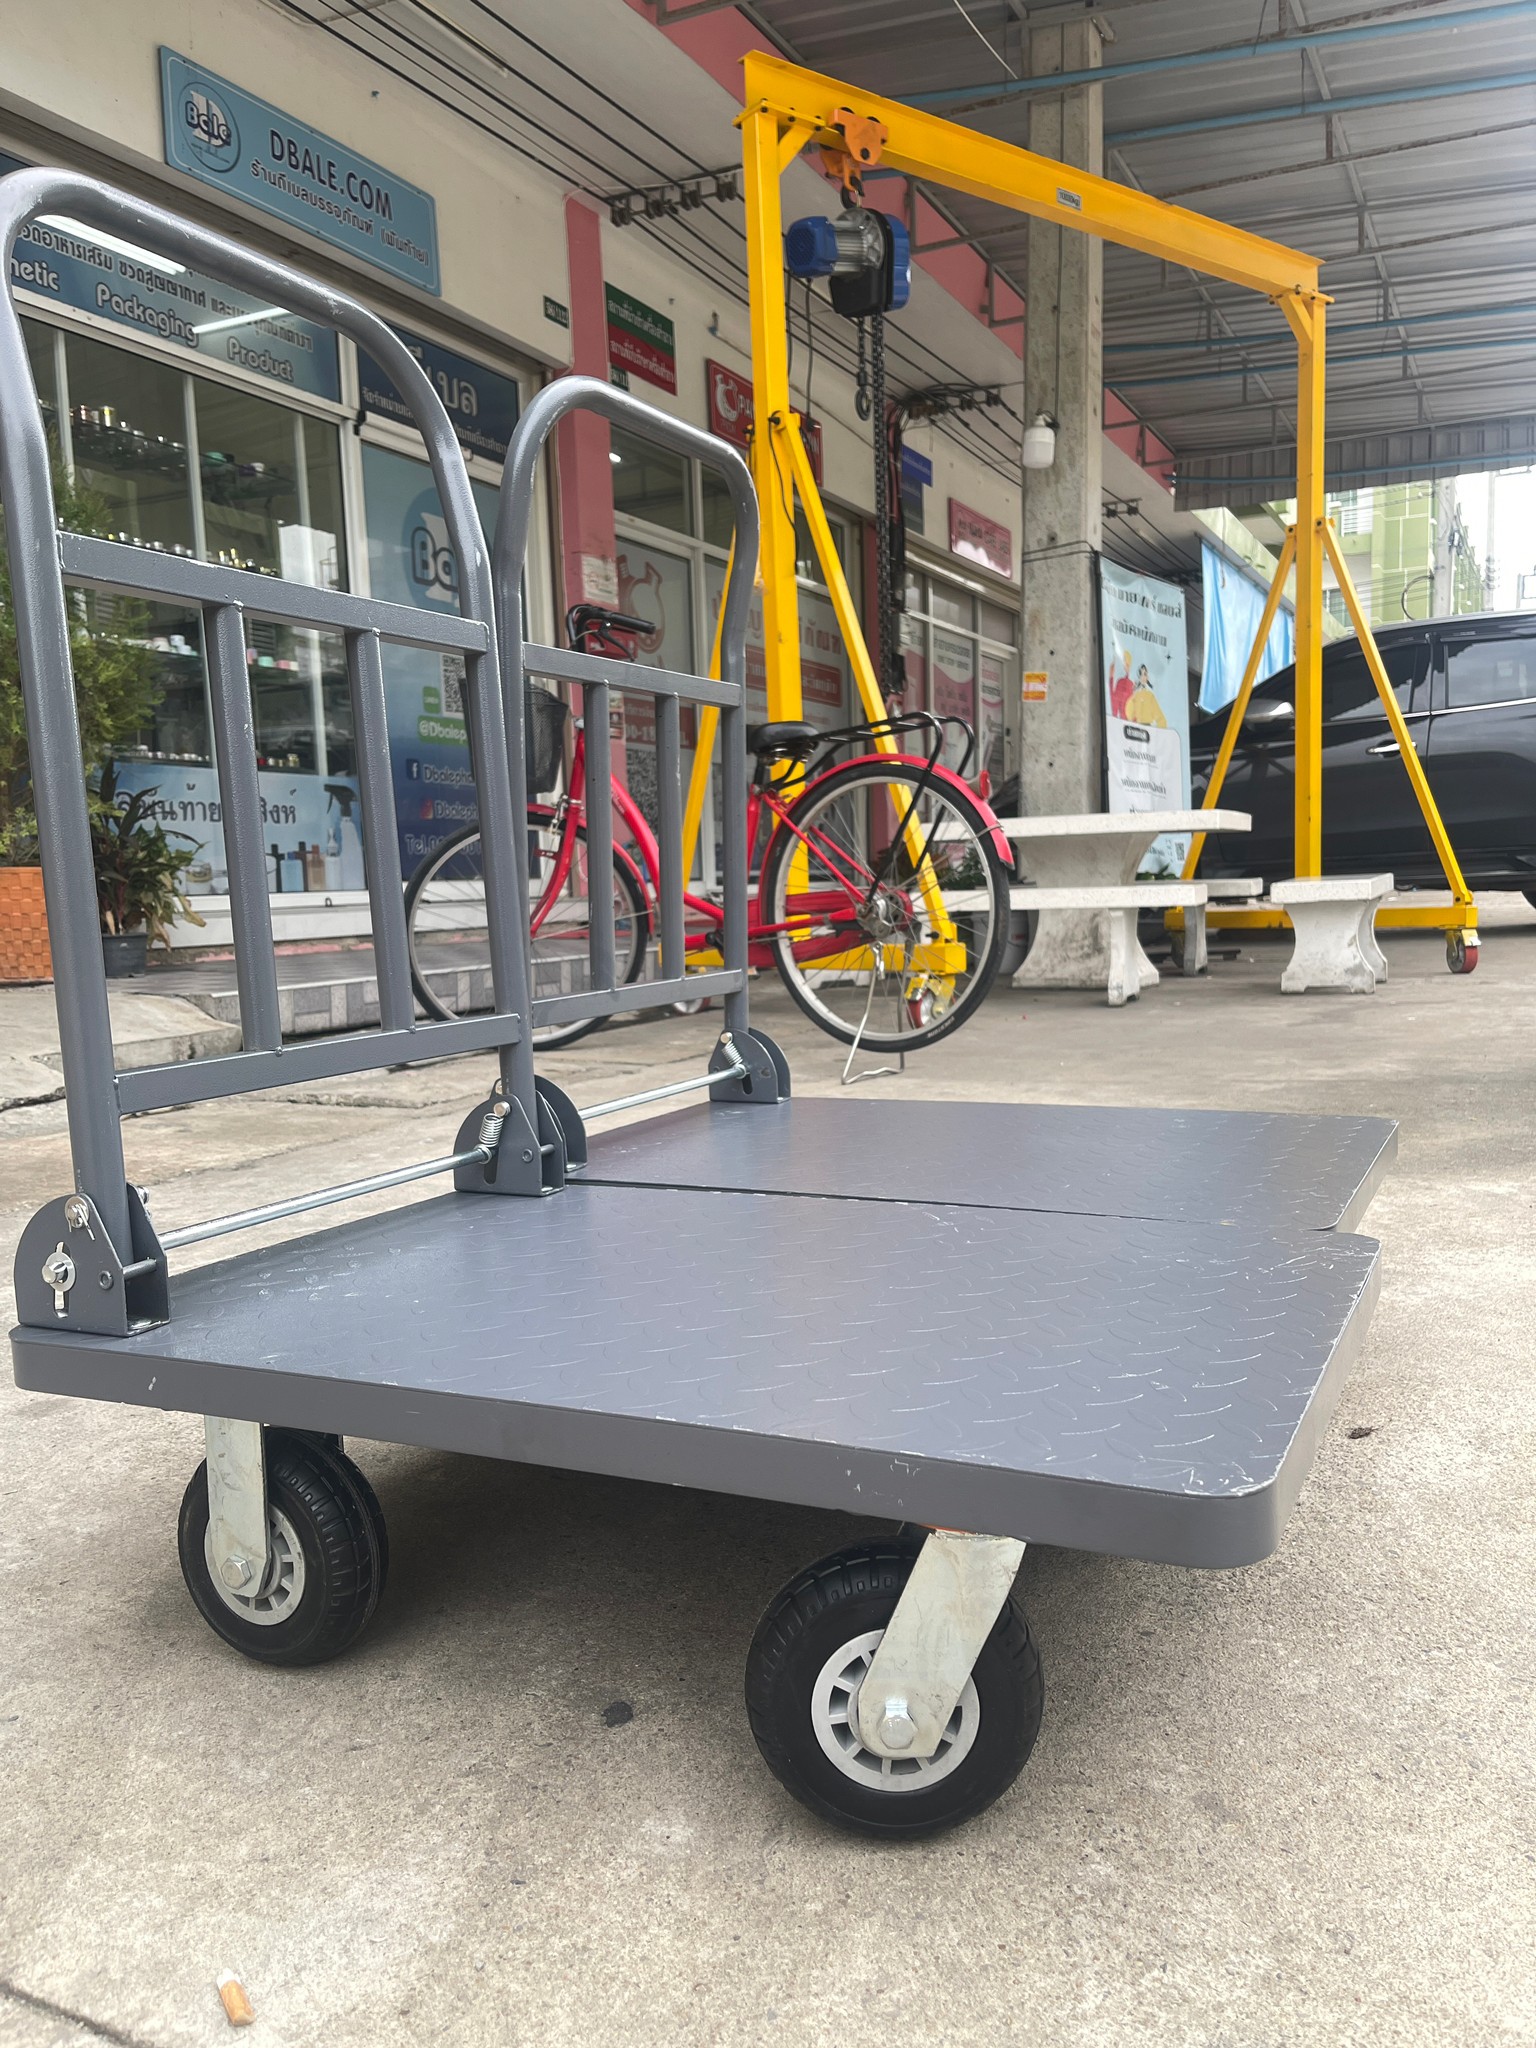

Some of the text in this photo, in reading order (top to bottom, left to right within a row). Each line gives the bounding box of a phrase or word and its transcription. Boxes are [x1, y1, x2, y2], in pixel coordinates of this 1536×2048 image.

[269, 128, 393, 222] DBALE.COM
[18, 223, 114, 272] วดอาหารเสริม
[96, 282, 200, 349] Packaging
[226, 335, 294, 383] Product
[410, 526, 460, 593] Ba
